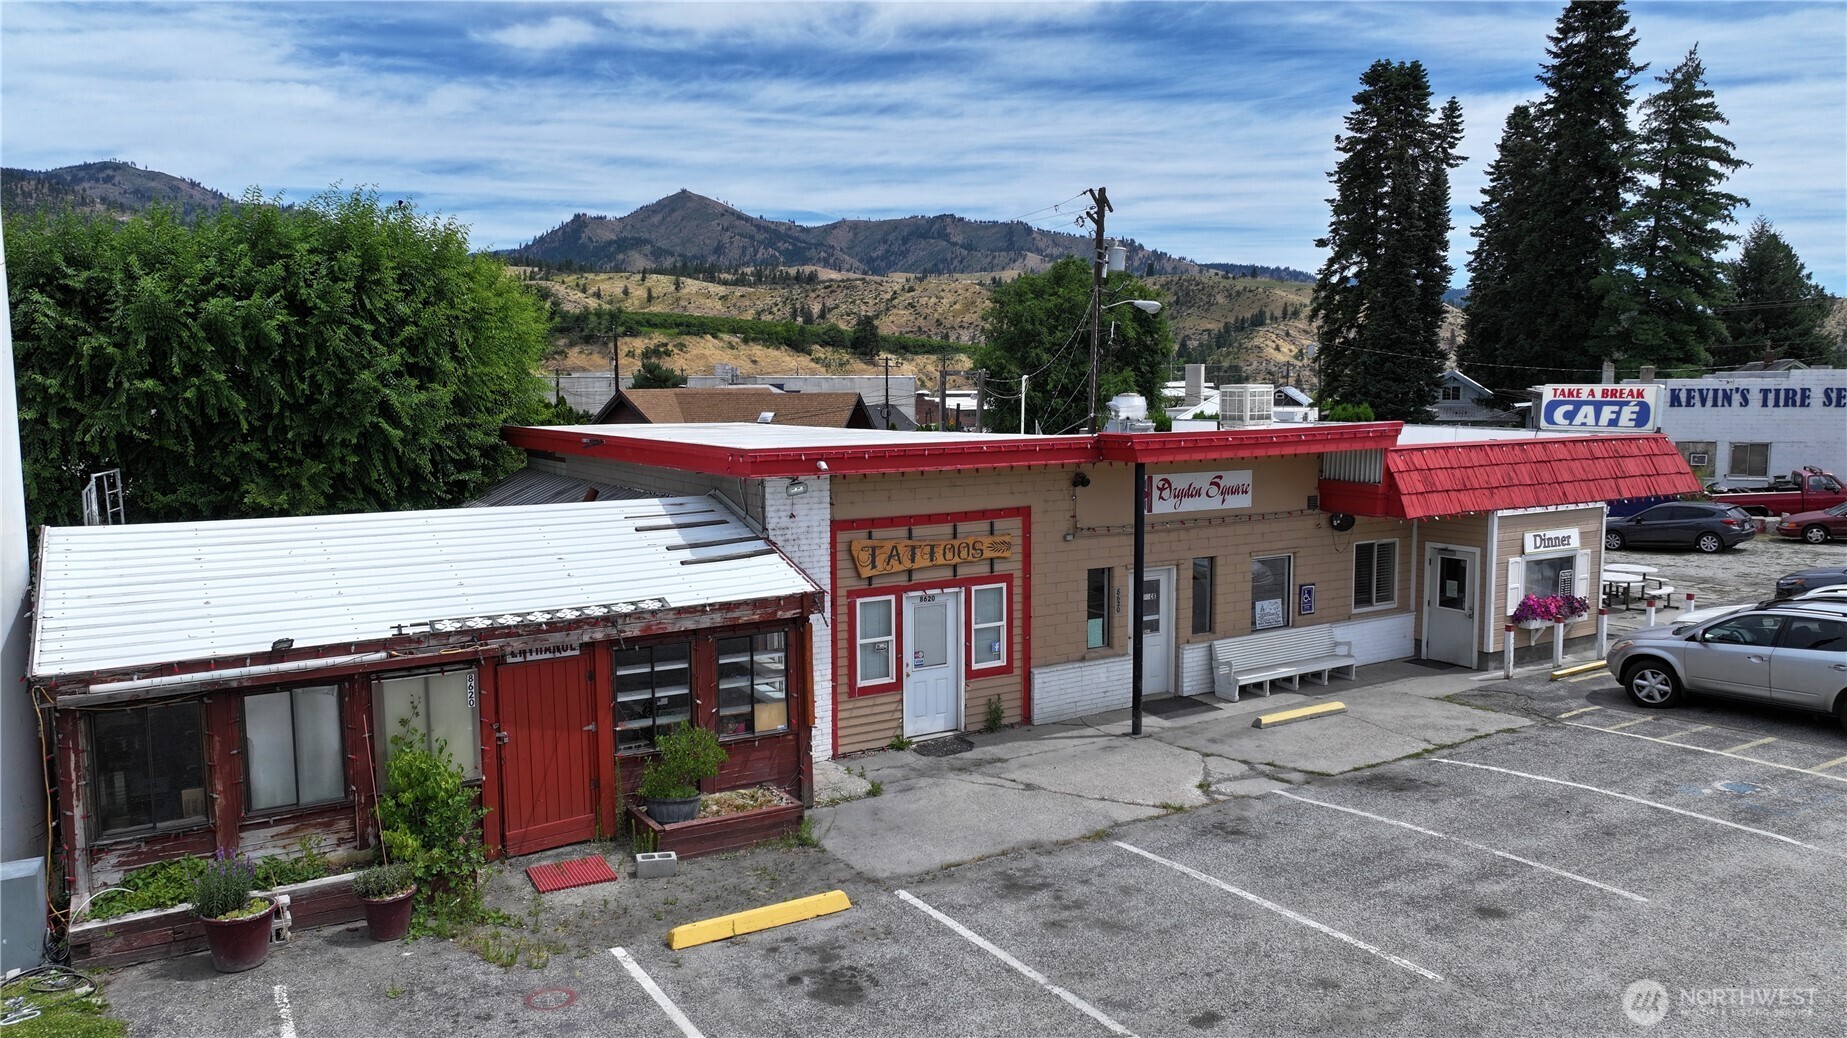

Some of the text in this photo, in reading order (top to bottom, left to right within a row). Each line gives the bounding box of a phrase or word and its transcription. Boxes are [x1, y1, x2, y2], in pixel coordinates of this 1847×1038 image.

[1552, 388, 1645, 399] TAKE A BREAK
[1668, 387, 1847, 408] KEVIN'S TIRE SE
[1553, 401, 1640, 427] CAFÉ
[1156, 474, 1250, 510] Dryden Square
[1533, 533, 1571, 550] Dinner
[857, 541, 984, 573] TATTOOS
[919, 595, 936, 603] 8620
[467, 674, 475, 707] 8620
